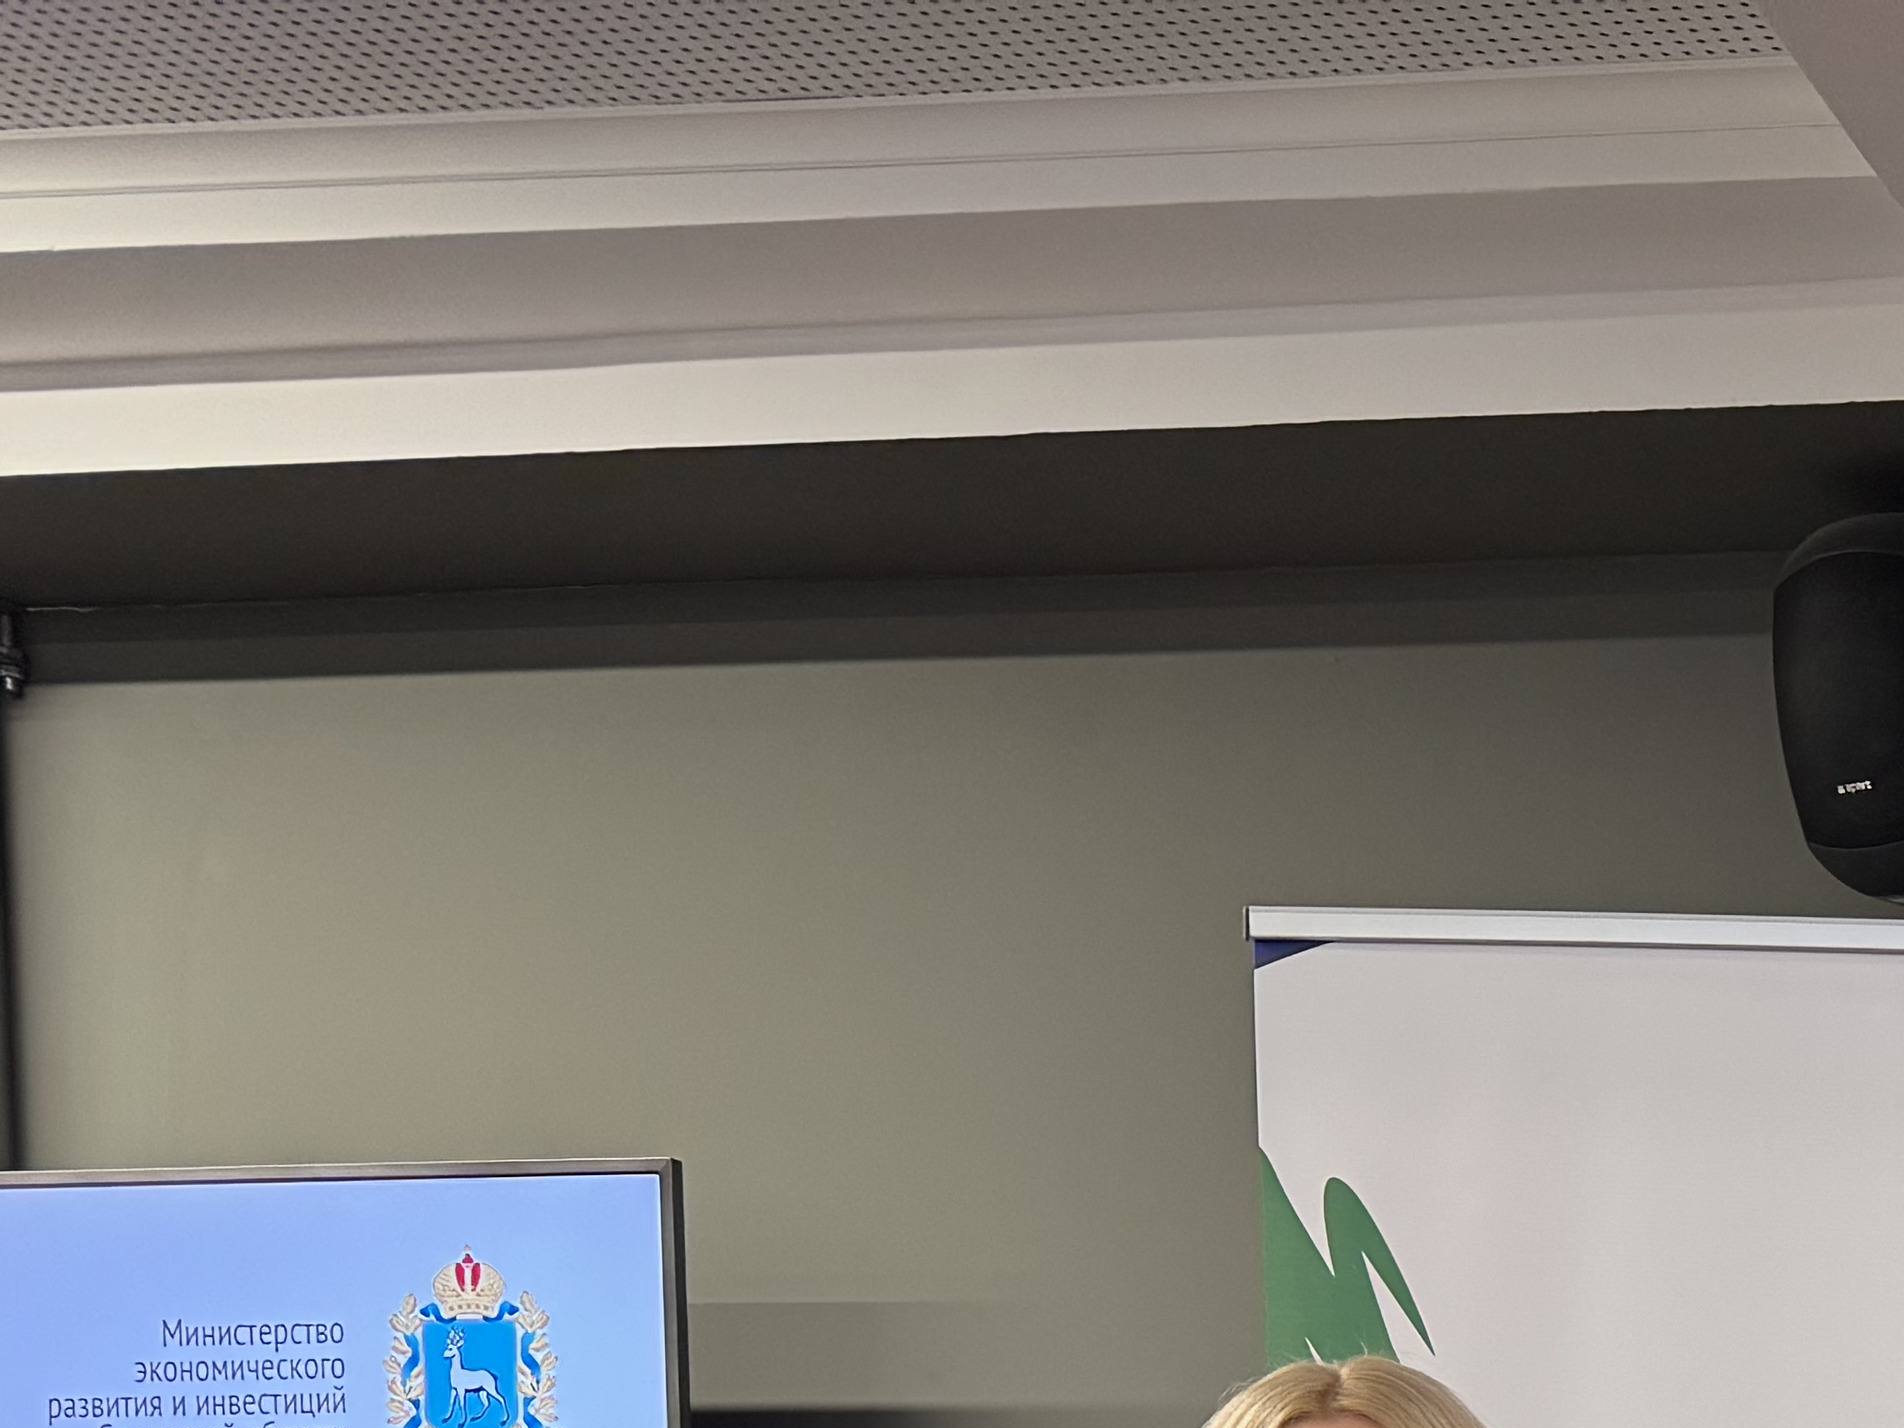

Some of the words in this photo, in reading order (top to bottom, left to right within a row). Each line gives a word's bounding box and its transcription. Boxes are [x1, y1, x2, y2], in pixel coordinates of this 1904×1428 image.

[162, 1318, 345, 1352] Министерство
[134, 1357, 346, 1383] экономического
[49, 1395, 162, 1426] развития
[172, 1395, 187, 1416] и
[197, 1385, 347, 1418] инвестиций
